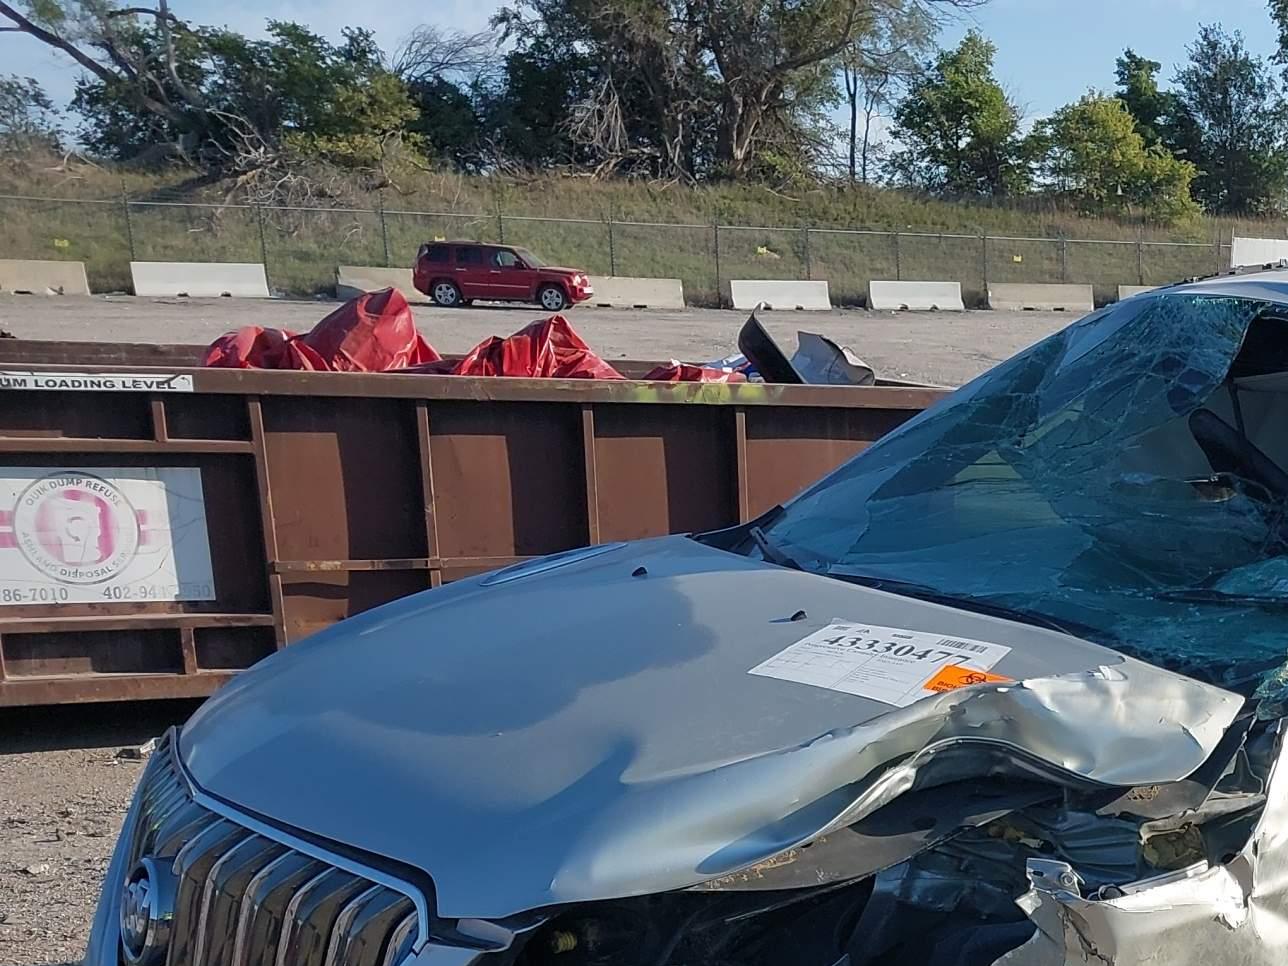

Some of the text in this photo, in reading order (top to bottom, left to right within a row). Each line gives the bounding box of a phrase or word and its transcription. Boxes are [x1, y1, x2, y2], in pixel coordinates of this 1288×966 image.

[34, 377, 117, 390] LOADING
[121, 379, 177, 390] LEVEL
[48, 477, 83, 490] DUMP
[85, 480, 122, 507] REFUSE
[59, 565, 113, 579] DISPOSAL
[822, 635, 971, 667] 43330477
